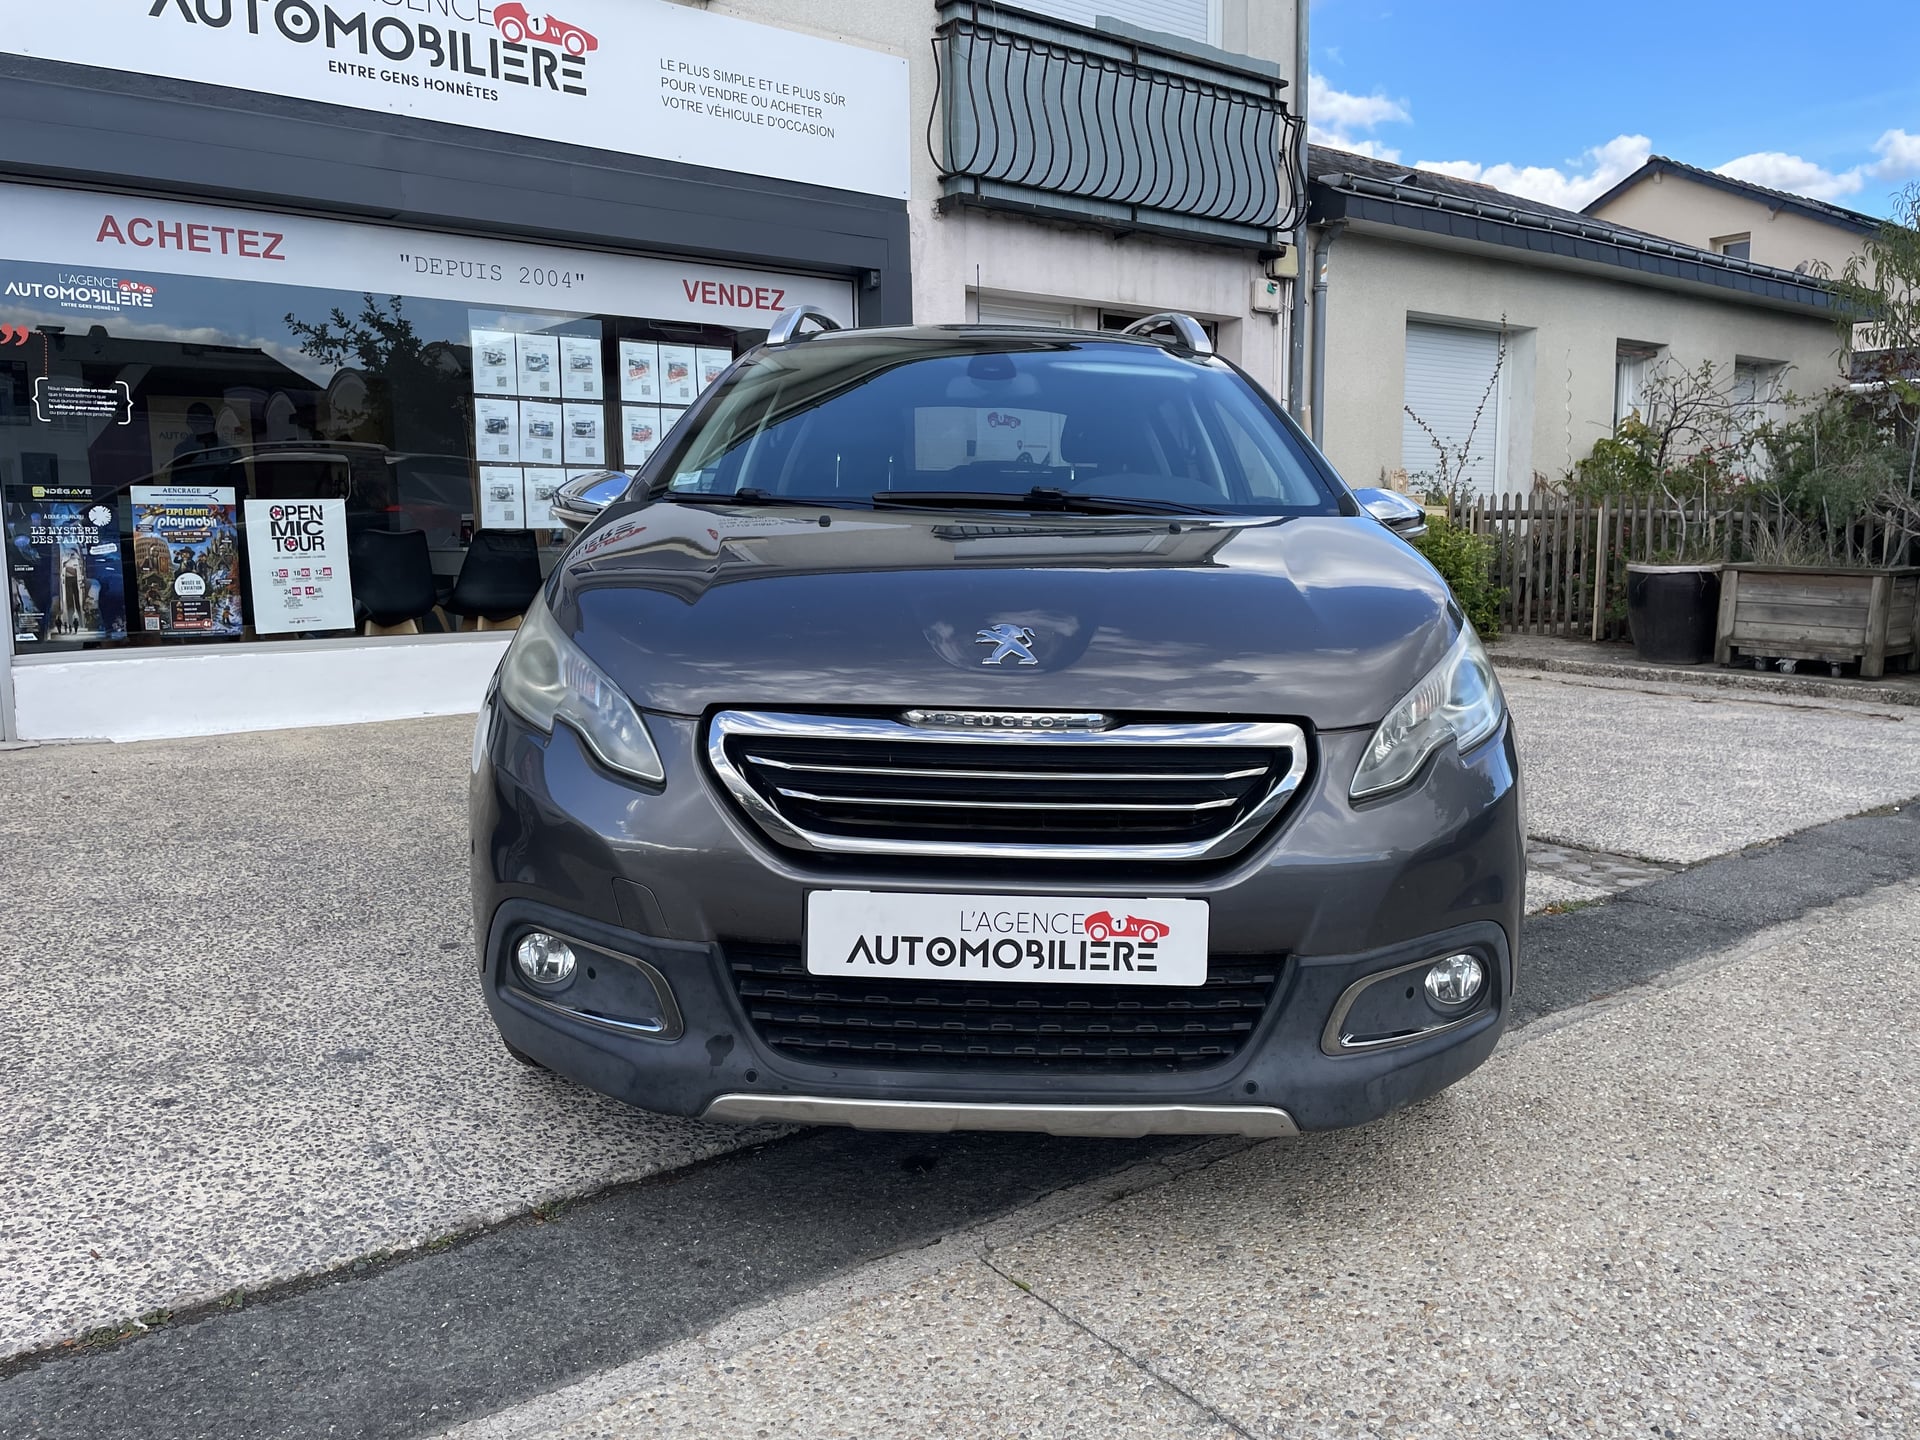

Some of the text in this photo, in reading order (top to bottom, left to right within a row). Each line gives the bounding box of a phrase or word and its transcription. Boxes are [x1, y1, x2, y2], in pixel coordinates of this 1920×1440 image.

[328, 60, 498, 101] ENTRE GENS HONNÊTES
[660, 58, 846, 107] LE PLUS SIMPLE ET LE PLUS SÛR
[661, 77, 823, 119] POUR VENDRE OU ACHETER
[661, 95, 835, 138] VOTRE VÉHICULE D'OCCASION
[96, 214, 286, 261] ACHETEZ
[400, 254, 584, 289] "DEPUIS 2004"
[58, 273, 119, 288] L'AGENCE
[682, 279, 785, 311] VENDEZ
[166, 507, 209, 516] EXPO GÉANTE
[269, 505, 323, 520] OPEN
[31, 523, 99, 535] LE MYSTÈRE
[157, 516, 217, 529] playmobil
[270, 520, 324, 536] MIC
[32, 536, 99, 544] DES FALUNS
[271, 536, 325, 552] TOUR
[943, 714, 1073, 728] PEUGEOT
[959, 911, 1085, 935] L'AGENCE
